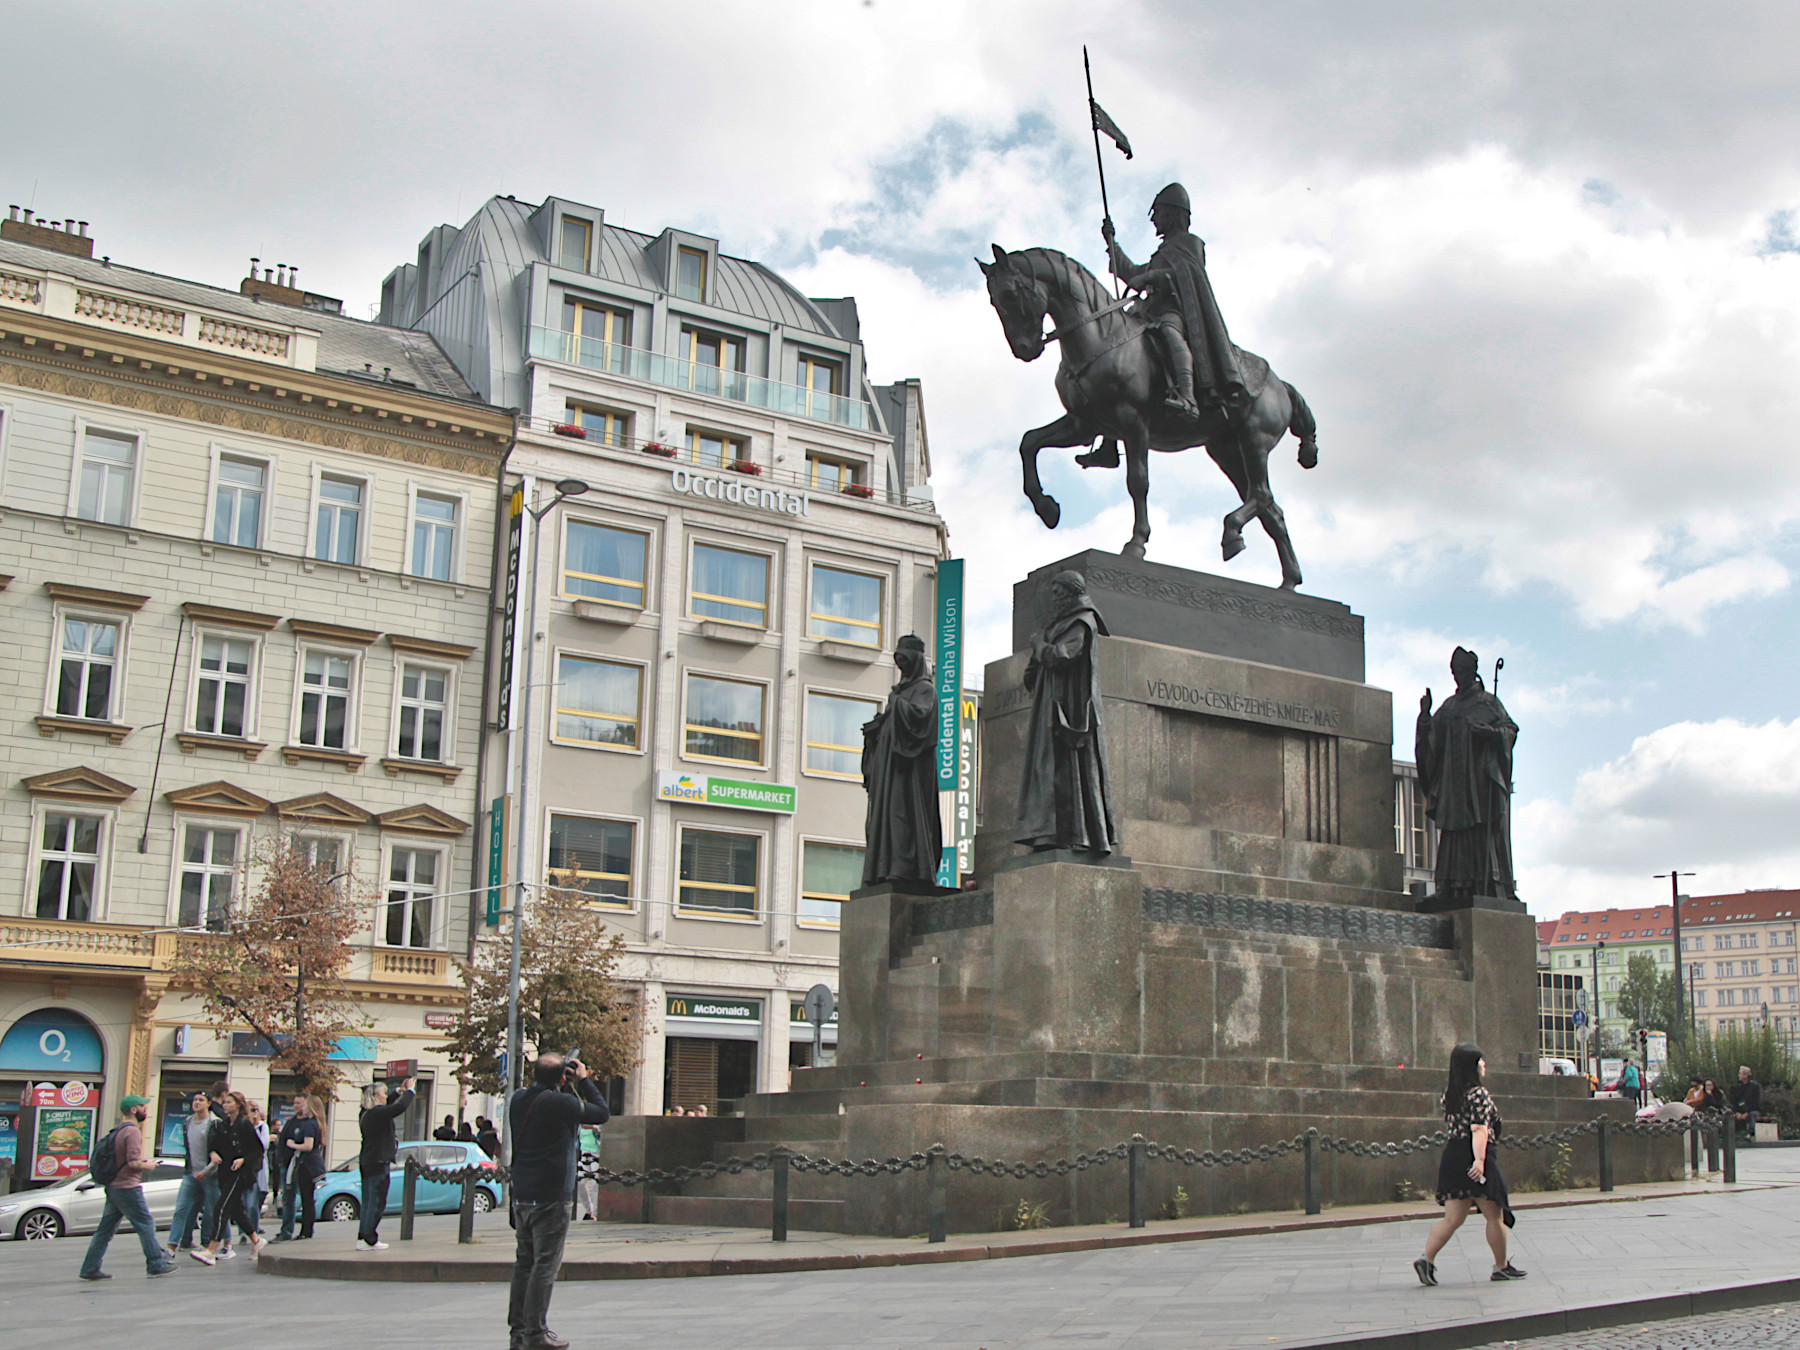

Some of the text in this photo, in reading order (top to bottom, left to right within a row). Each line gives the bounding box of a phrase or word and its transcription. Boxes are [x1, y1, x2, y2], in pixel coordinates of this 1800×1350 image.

[671, 469, 809, 517] Occidental
[500, 529, 520, 729] McDonald's
[940, 598, 956, 779] Occidental Praha Wilson
[663, 784, 792, 804] albert SUPERMARKET
[492, 810, 501, 913] HOTEL
[694, 1003, 750, 1017] McDonald's
[66, 1089, 85, 1099] KING
